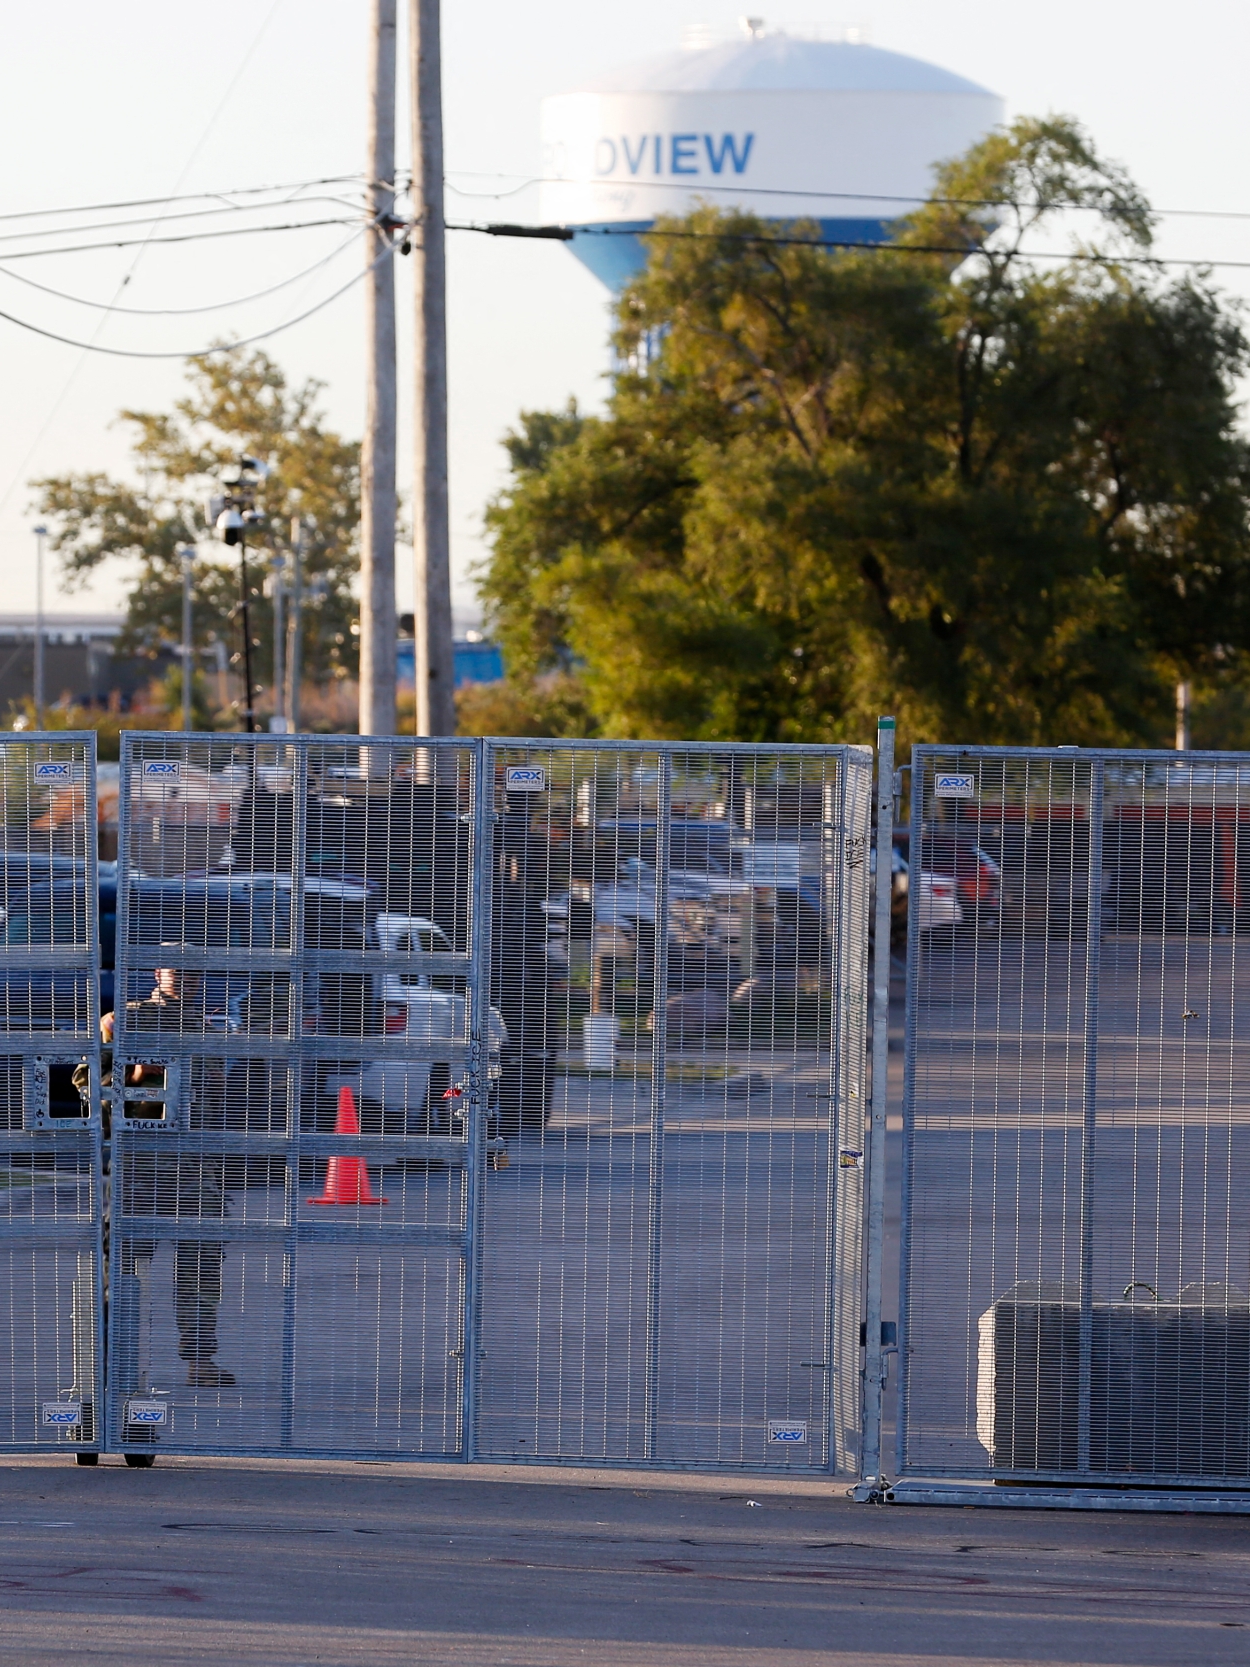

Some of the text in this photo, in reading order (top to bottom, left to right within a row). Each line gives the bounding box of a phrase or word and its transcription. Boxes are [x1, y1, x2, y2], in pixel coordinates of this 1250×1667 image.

[37, 765, 68, 774] ARX
[146, 764, 177, 772] ARX
[510, 771, 541, 780] ARX
[939, 778, 970, 786] ARX
[132, 1120, 155, 1129] FUCK
[46, 1413, 77, 1422] ARX
[131, 1411, 163, 1421] ARX
[772, 1431, 803, 1441] ARX
